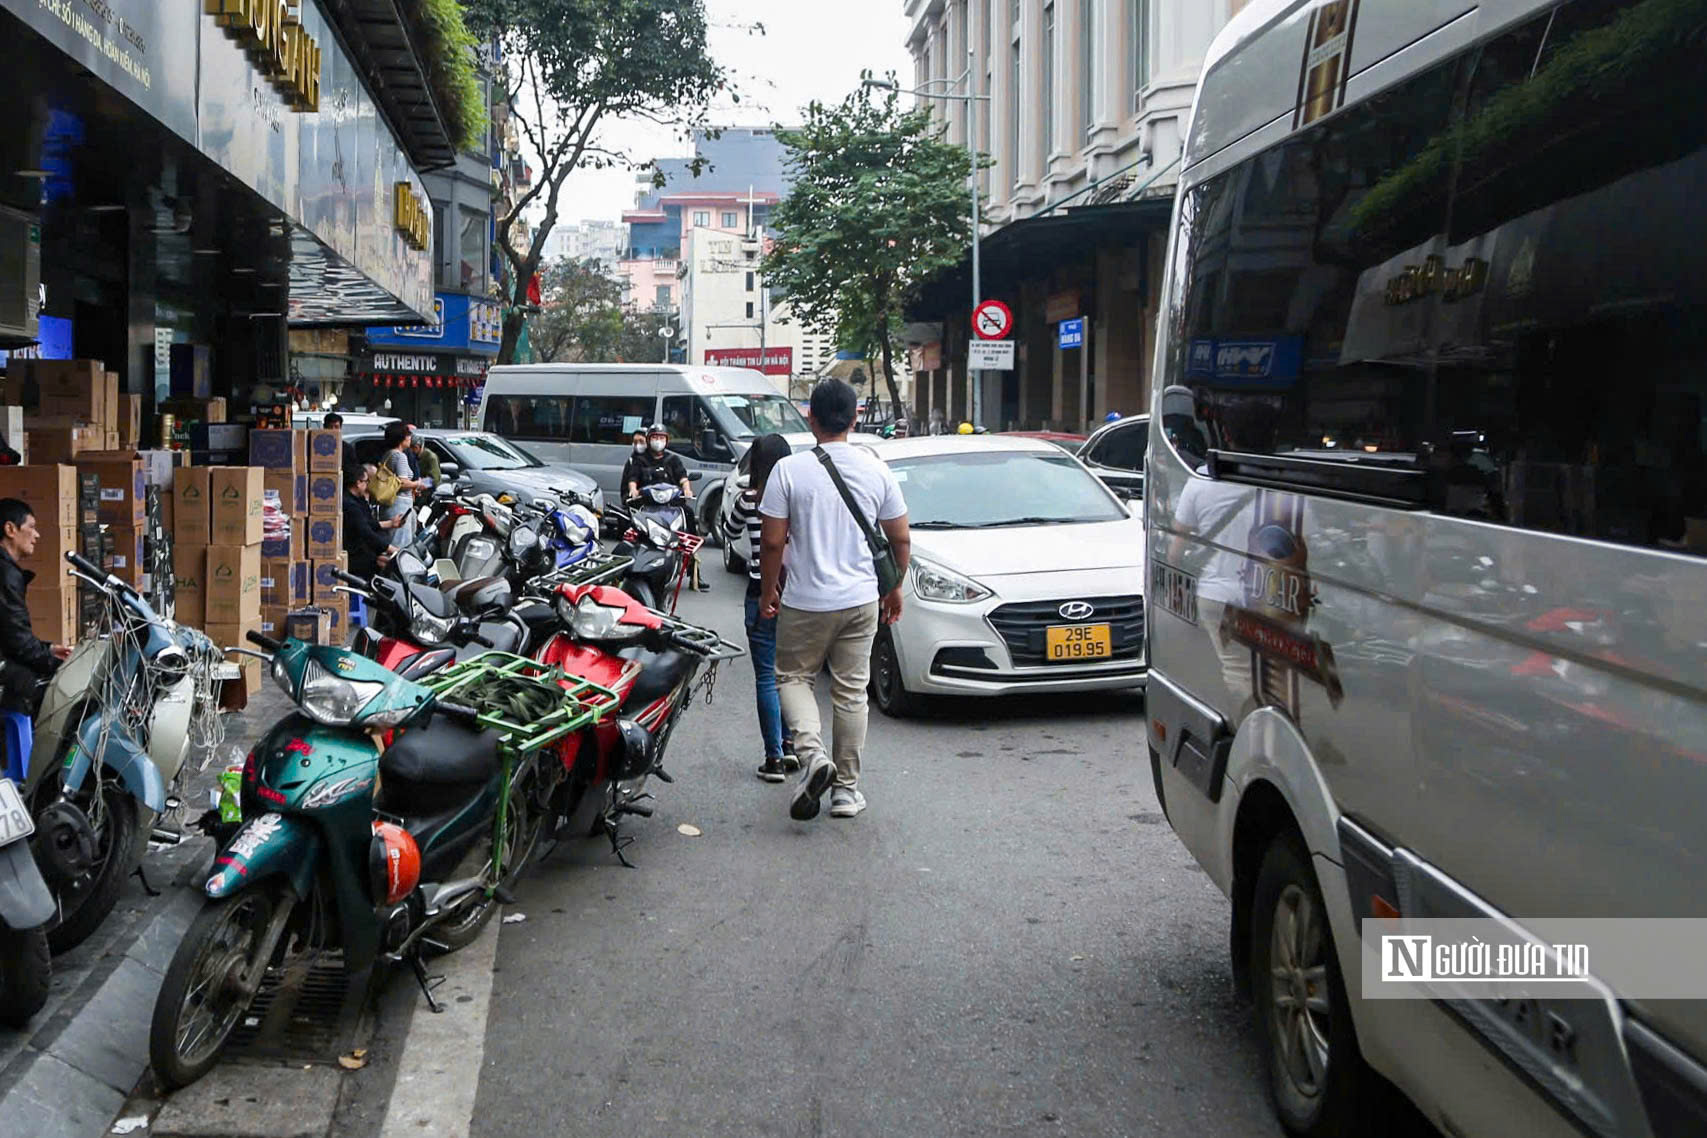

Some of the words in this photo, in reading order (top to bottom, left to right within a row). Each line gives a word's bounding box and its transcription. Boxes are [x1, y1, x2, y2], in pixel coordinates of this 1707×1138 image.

[374, 354, 437, 371] AUTHENTIC
[1252, 563, 1301, 616] DCAR
[1065, 627, 1093, 642] 29E
[1054, 641, 1104, 658] 019.95
